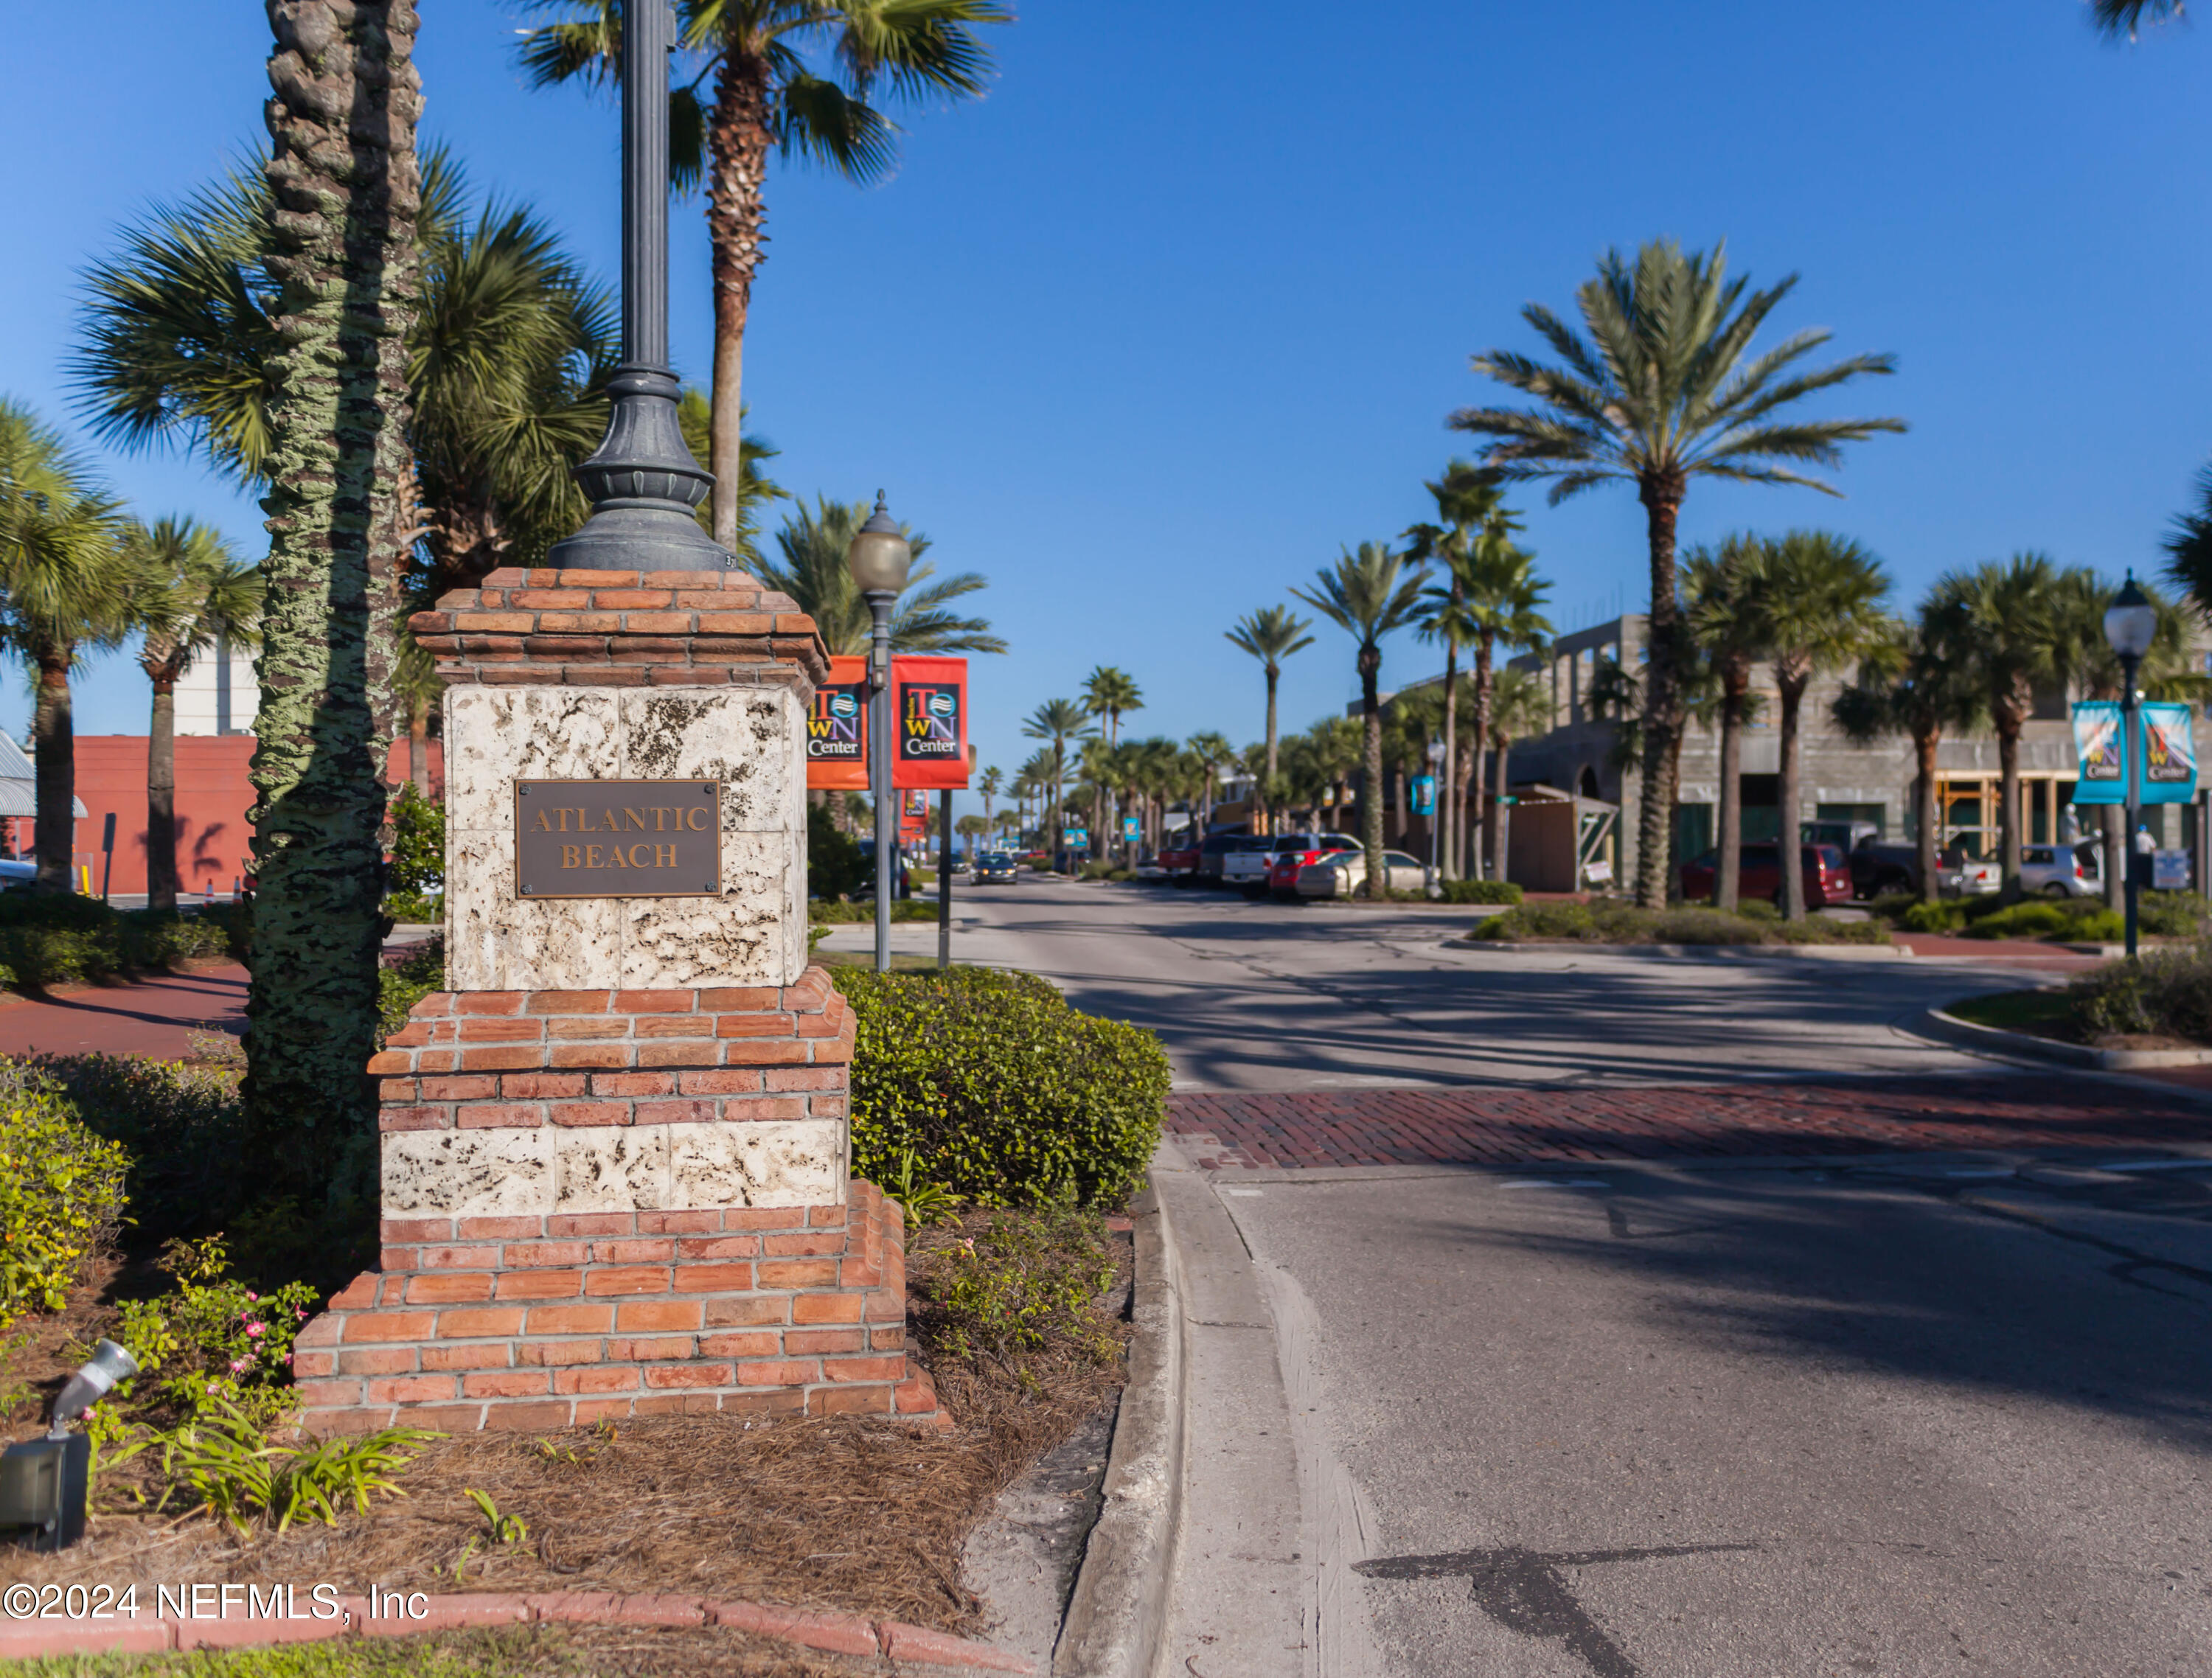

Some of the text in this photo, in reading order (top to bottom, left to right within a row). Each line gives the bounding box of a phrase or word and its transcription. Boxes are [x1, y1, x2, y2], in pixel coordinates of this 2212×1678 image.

[808, 739, 858, 756] Center
[906, 738, 956, 755] Center
[530, 807, 709, 832] ATLANTIC
[560, 843, 679, 868] BEACH
